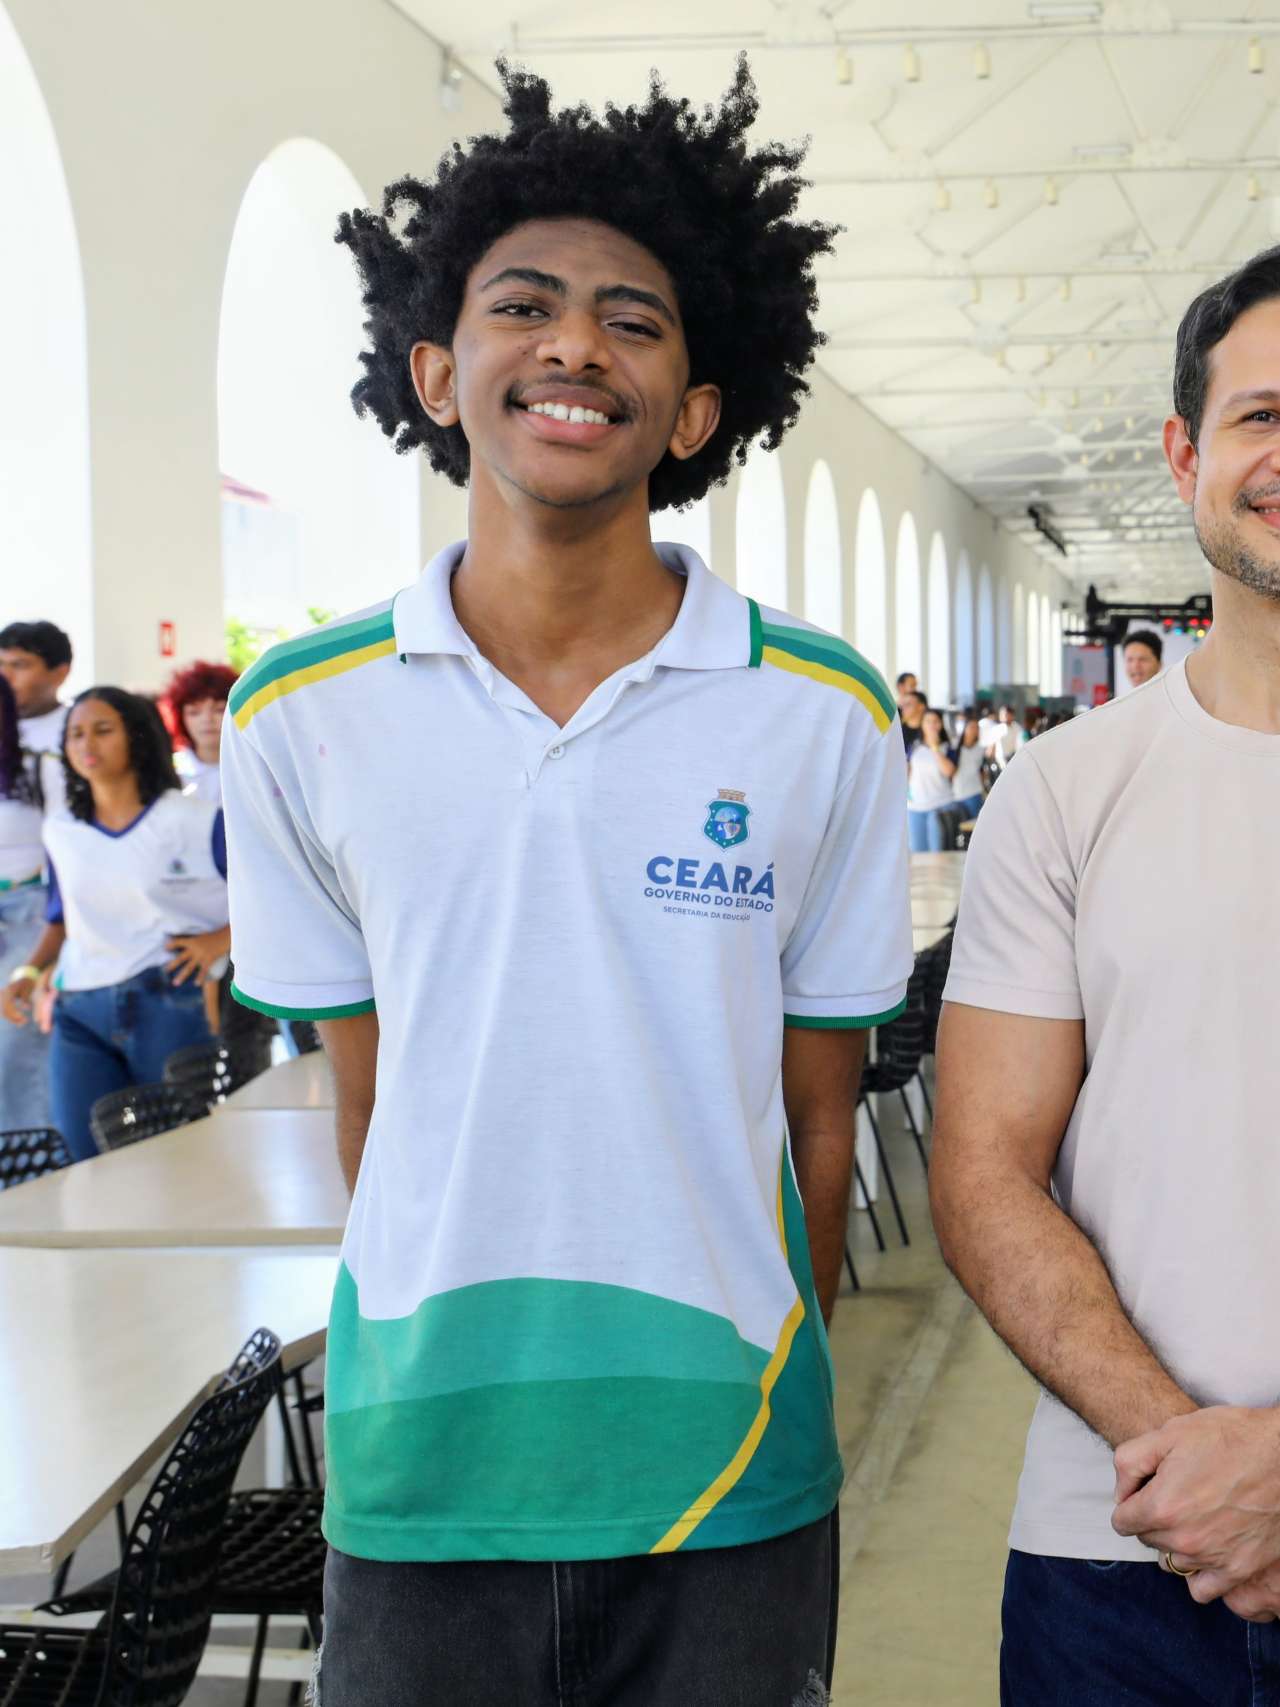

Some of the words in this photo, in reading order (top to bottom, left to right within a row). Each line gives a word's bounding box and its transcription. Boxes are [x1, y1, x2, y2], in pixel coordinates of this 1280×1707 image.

[646, 856, 775, 899] CEARÁ
[644, 887, 711, 904] GOVERNO
[714, 895, 733, 907] DO
[735, 898, 774, 912] ESTADO
[663, 905, 709, 918] SECRETARIA
[710, 911, 721, 919] DA
